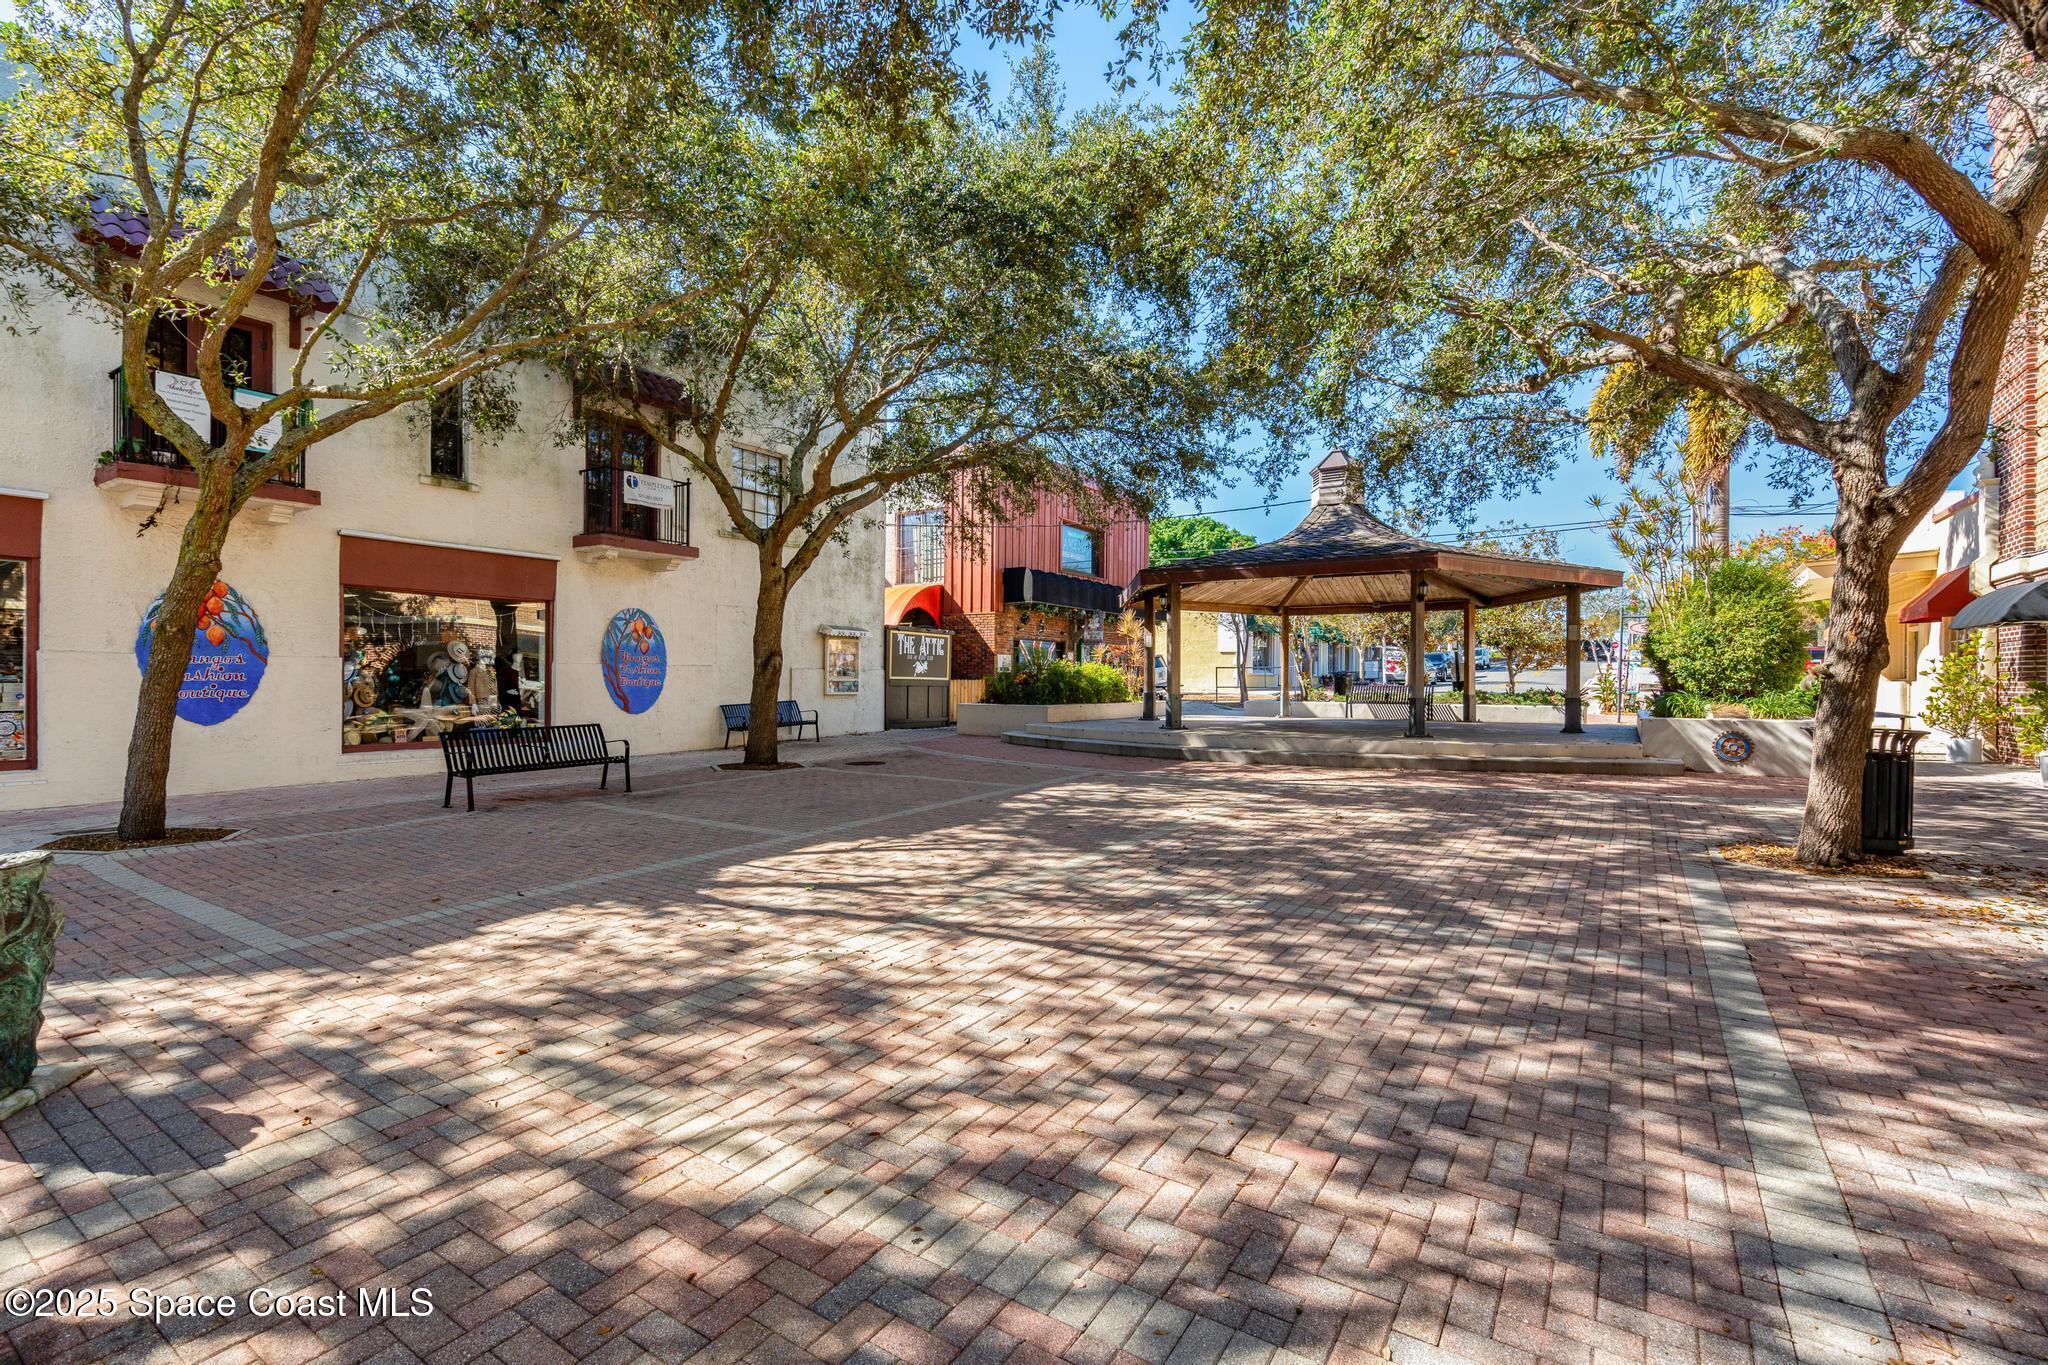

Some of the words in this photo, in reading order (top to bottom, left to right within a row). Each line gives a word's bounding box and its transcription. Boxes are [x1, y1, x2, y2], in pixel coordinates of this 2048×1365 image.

[641, 480, 671, 490] TEMPLETON
[897, 633, 915, 655] THE
[920, 635, 944, 656] ATTIC
[178, 684, 250, 702] outique
